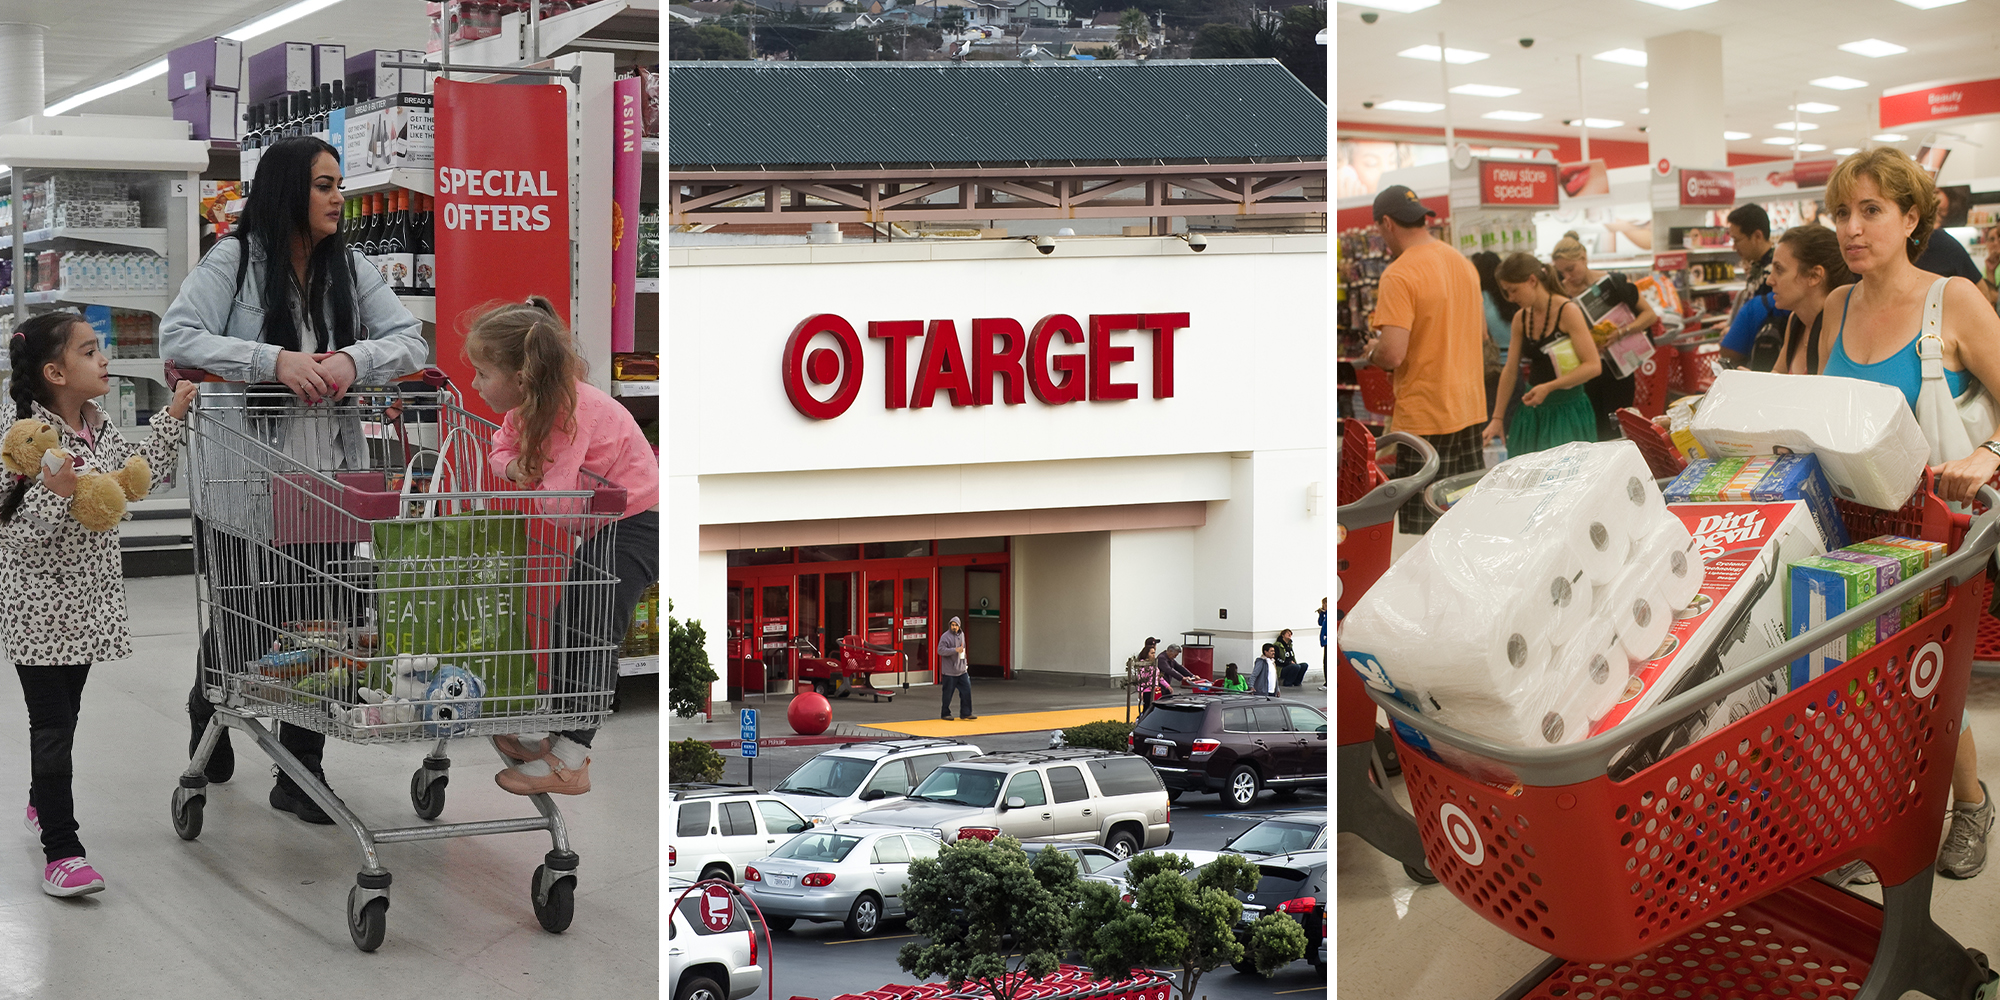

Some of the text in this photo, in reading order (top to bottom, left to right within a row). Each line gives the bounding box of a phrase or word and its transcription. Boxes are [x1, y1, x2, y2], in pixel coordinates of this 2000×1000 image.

[1928, 91, 1963, 104] Beauty
[623, 95, 634, 152] ASIAN
[332, 132, 342, 144] We
[177, 184, 182, 192] S
[439, 166, 558, 197] SPECIAL
[1493, 168, 1547, 183] new store
[1493, 183, 1534, 201] special
[443, 202, 551, 231] OFFERS
[868, 312, 1190, 410] TARGET
[1692, 509, 1760, 536] Dirt
[1693, 518, 1766, 548] Devil
